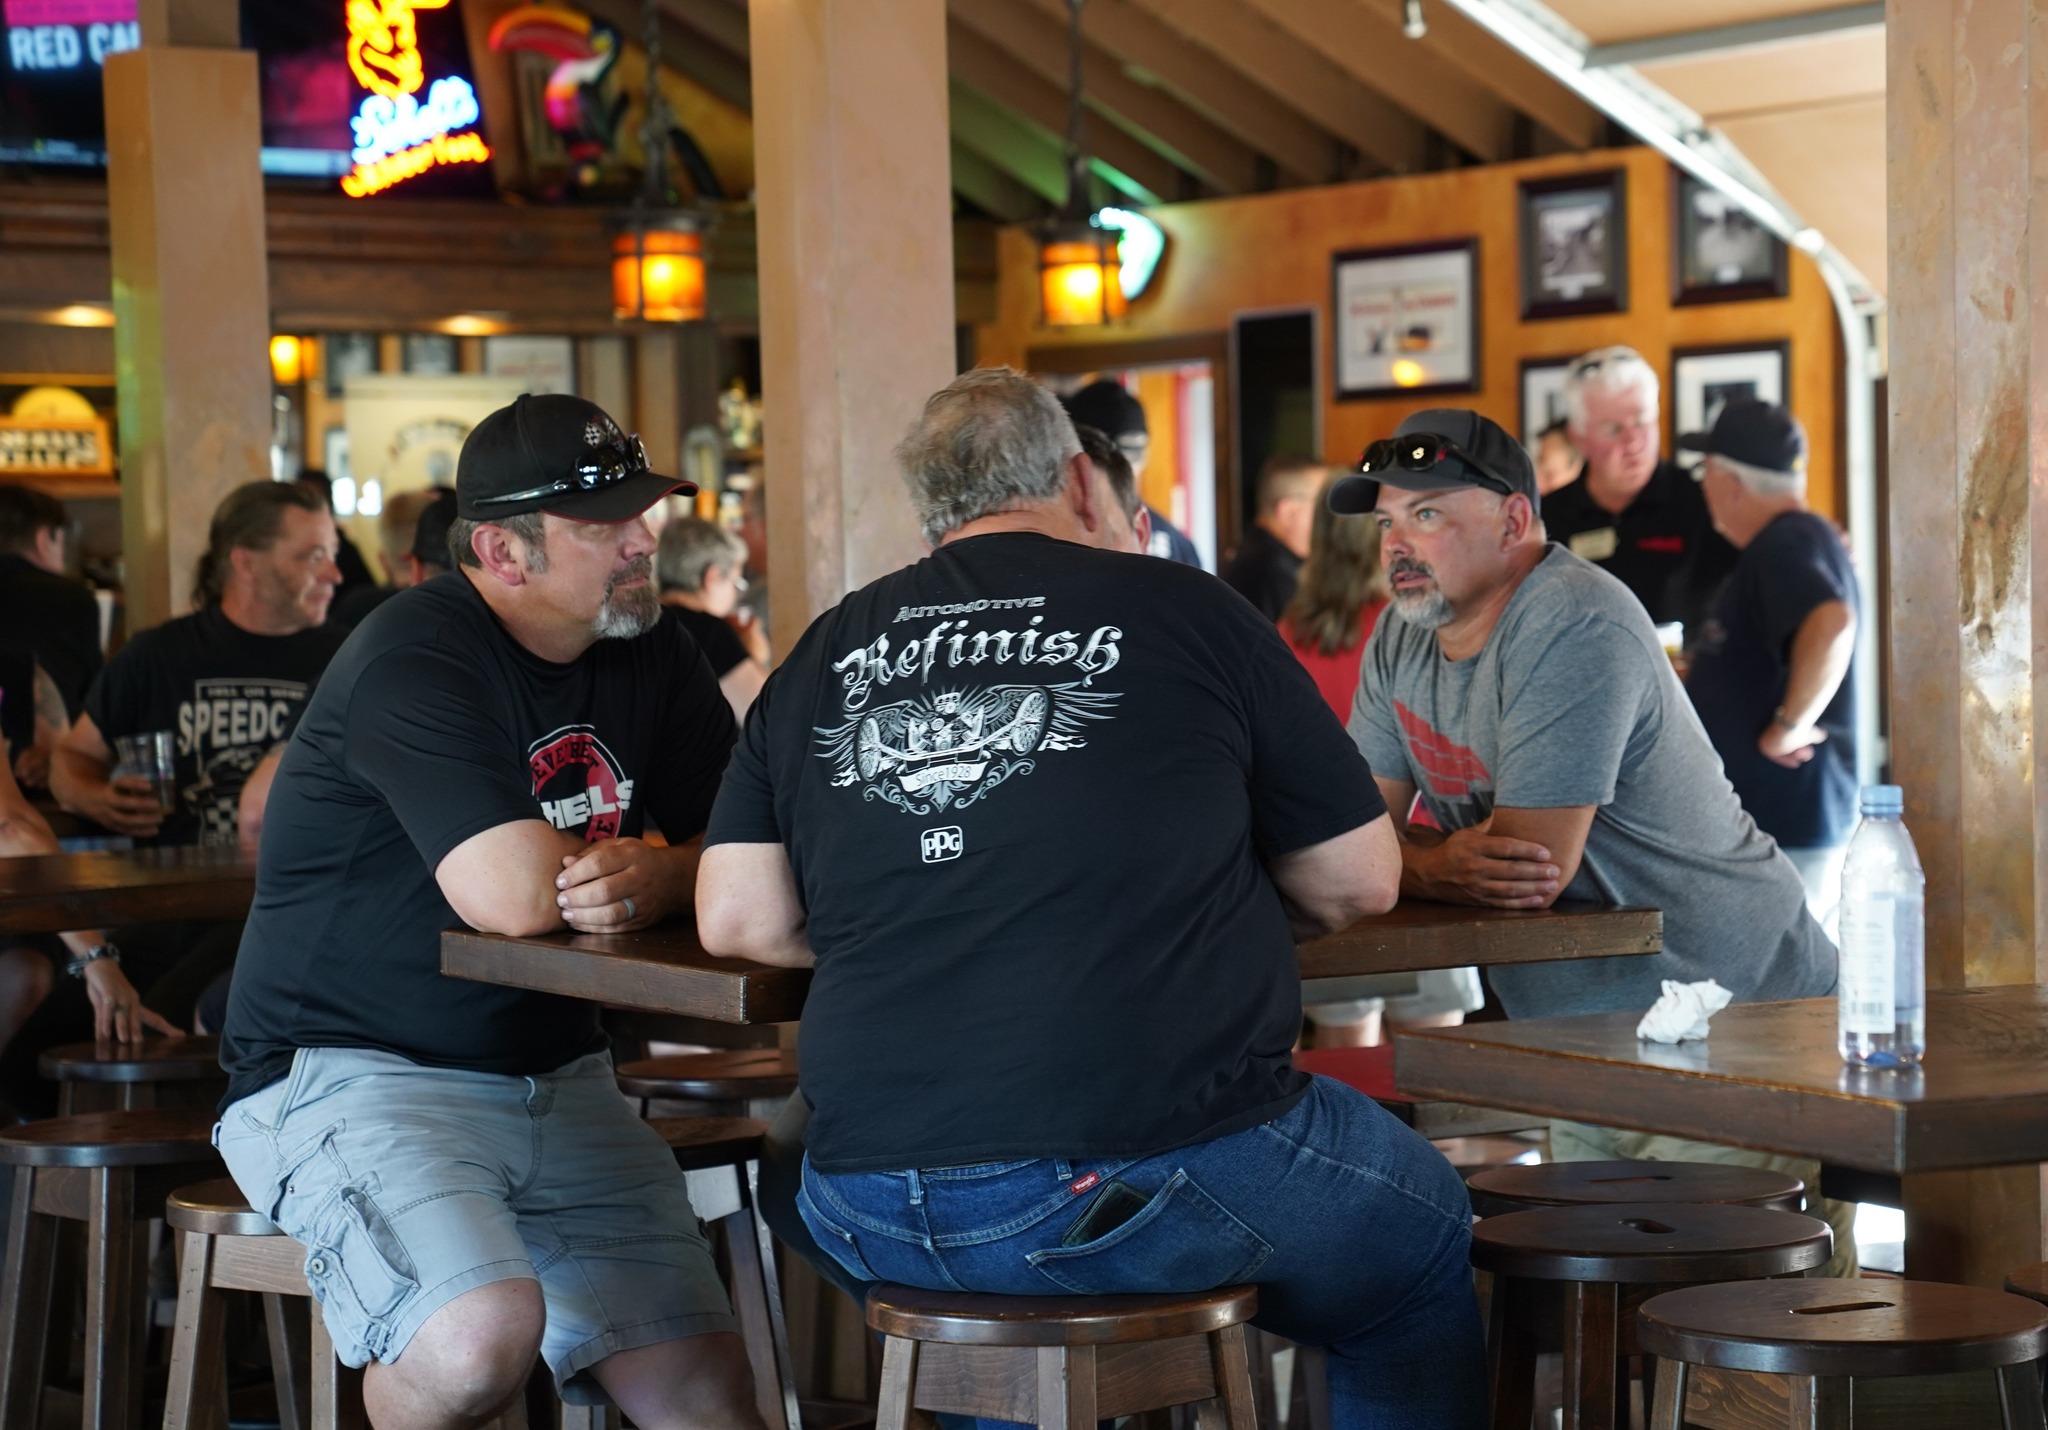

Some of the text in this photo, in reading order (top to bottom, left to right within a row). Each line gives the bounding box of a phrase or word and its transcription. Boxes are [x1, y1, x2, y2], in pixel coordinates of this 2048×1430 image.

[9, 21, 140, 69] RED CA
[892, 596, 1047, 623] AUTOMOTIVE
[831, 612, 1124, 711] Refinish
[924, 831, 960, 858] PPG
